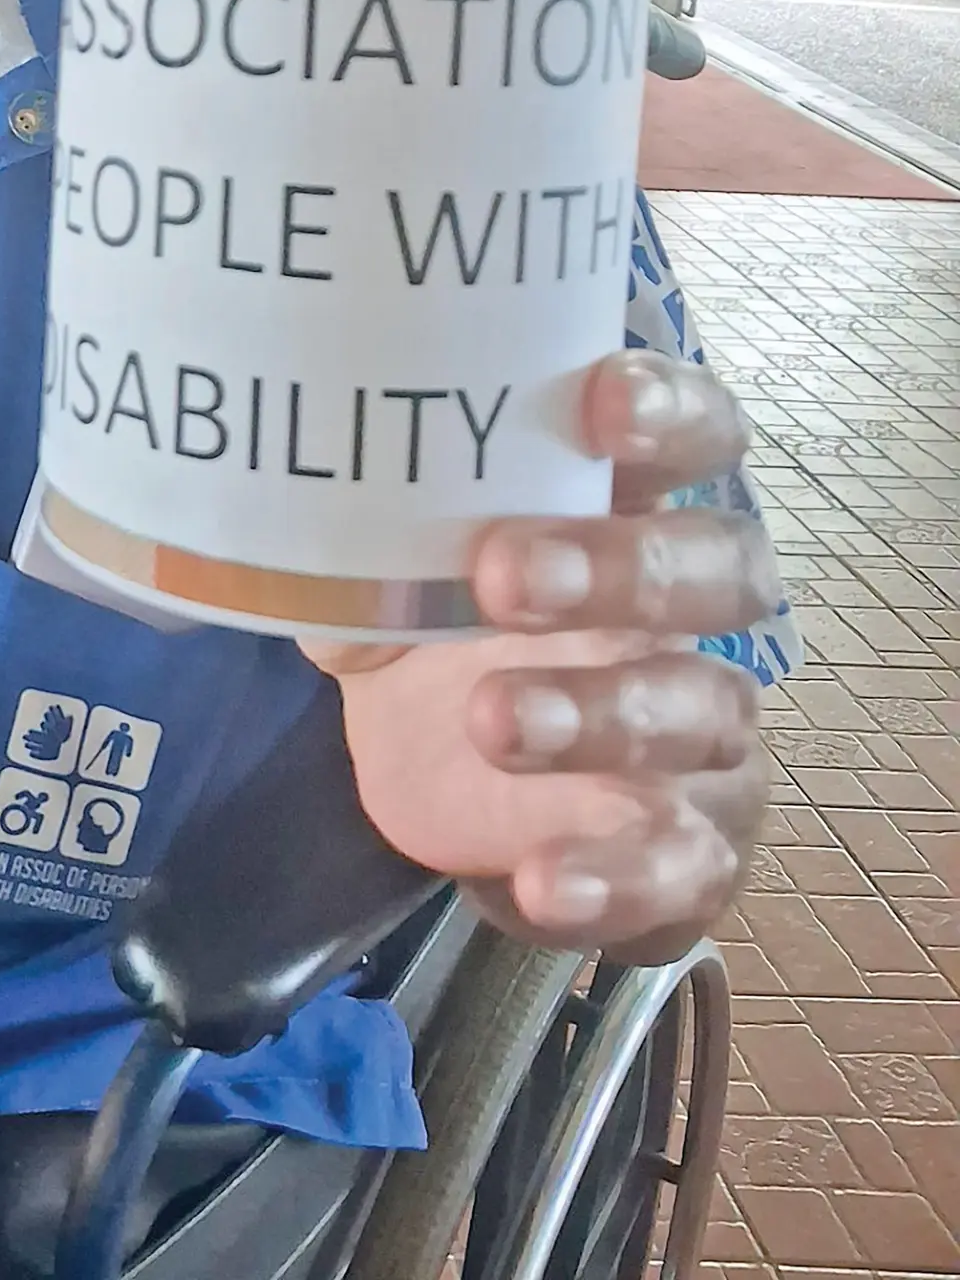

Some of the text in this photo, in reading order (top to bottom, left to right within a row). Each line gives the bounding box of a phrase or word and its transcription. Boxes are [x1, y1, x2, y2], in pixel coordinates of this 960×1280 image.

[54, 140, 624, 286] EOPLE WITH
[10, 855, 65, 885] ASSOC
[66, 867, 88, 889] OF
[13, 882, 113, 921] DISABILITIES
